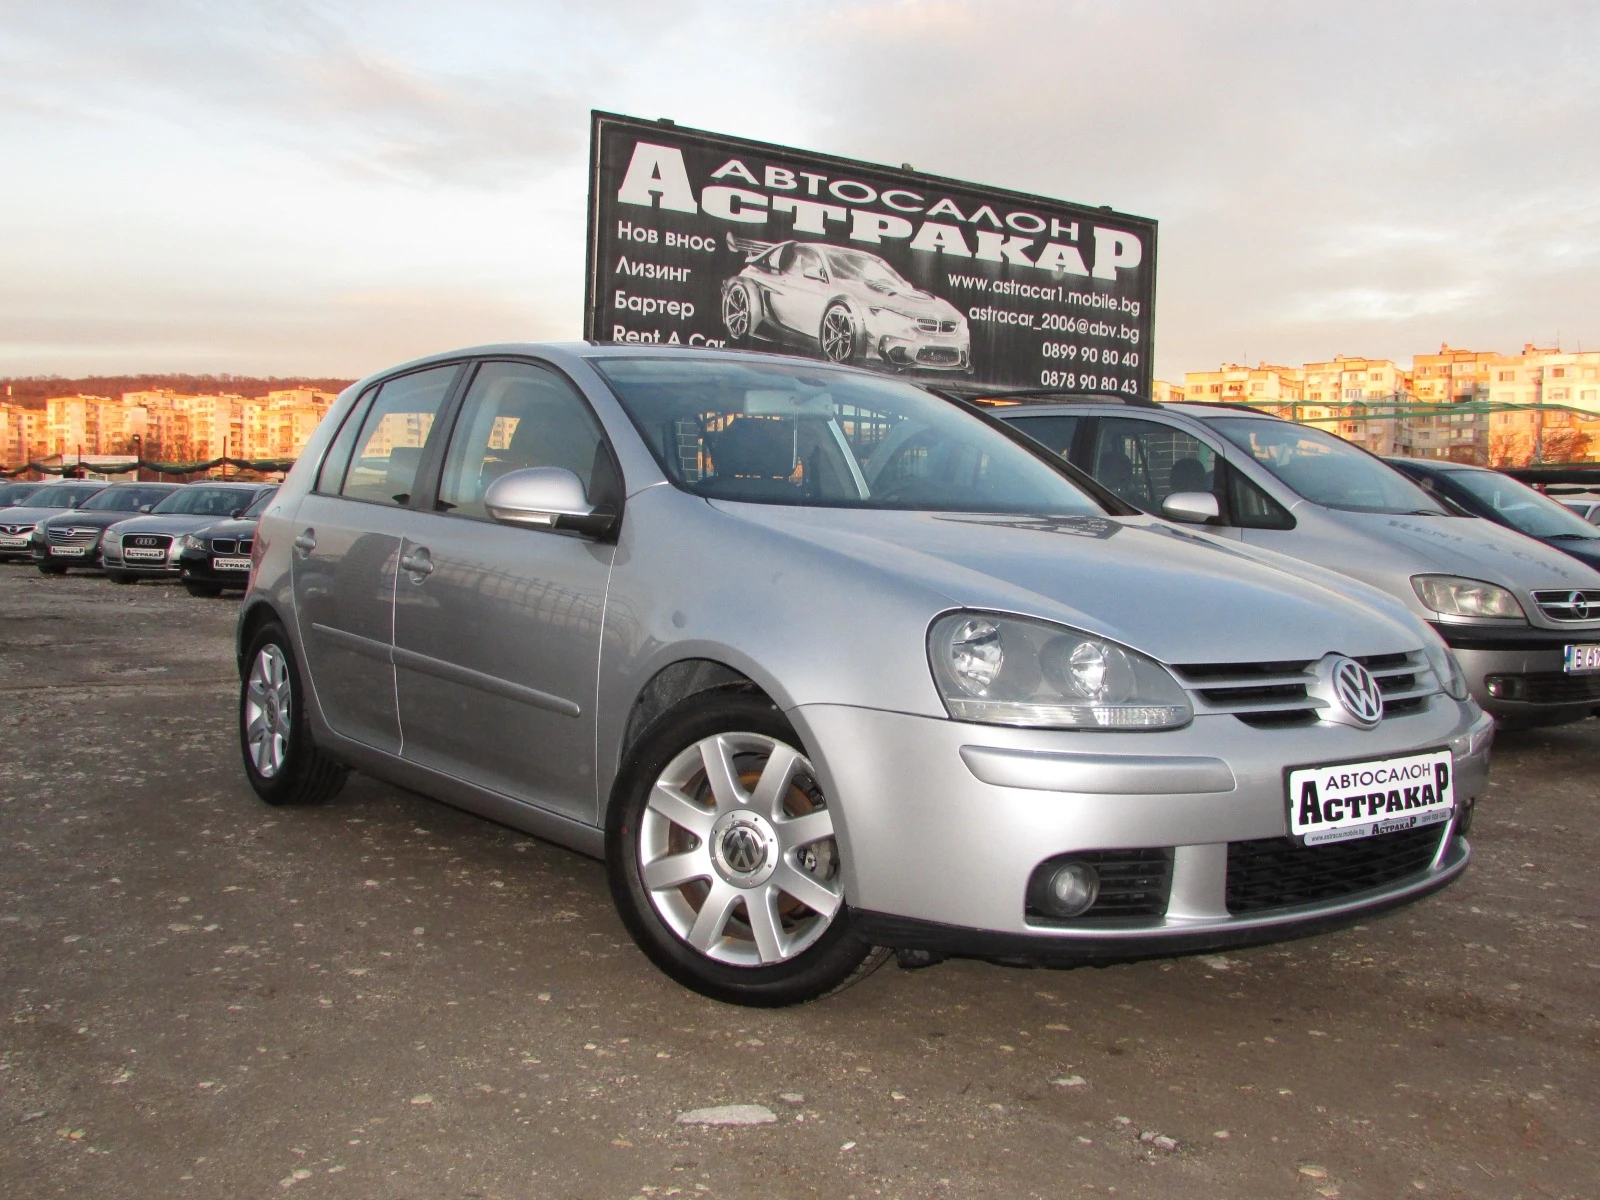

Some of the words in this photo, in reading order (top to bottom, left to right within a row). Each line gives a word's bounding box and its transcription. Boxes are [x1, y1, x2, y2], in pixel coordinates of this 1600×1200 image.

[711, 159, 1079, 241] АВТОСАЛОН
[615, 256, 691, 282] Лизинг
[614, 290, 694, 320] Бартер
[948, 273, 1141, 316] www.astracar1.mobile.bg
[968, 305, 1140, 344] astracar_2006@abv.bg
[1042, 342, 1077, 360] 0899
[1081, 347, 1098, 363] 90
[1102, 349, 1119, 365] 80
[1121, 352, 1139, 368] 40
[1041, 370, 1076, 388] 0878
[1079, 374, 1097, 390] 90
[1100, 377, 1118, 391] 80
[1121, 379, 1138, 395] 43
[1325, 763, 1431, 791] АВТОСАЛОН
